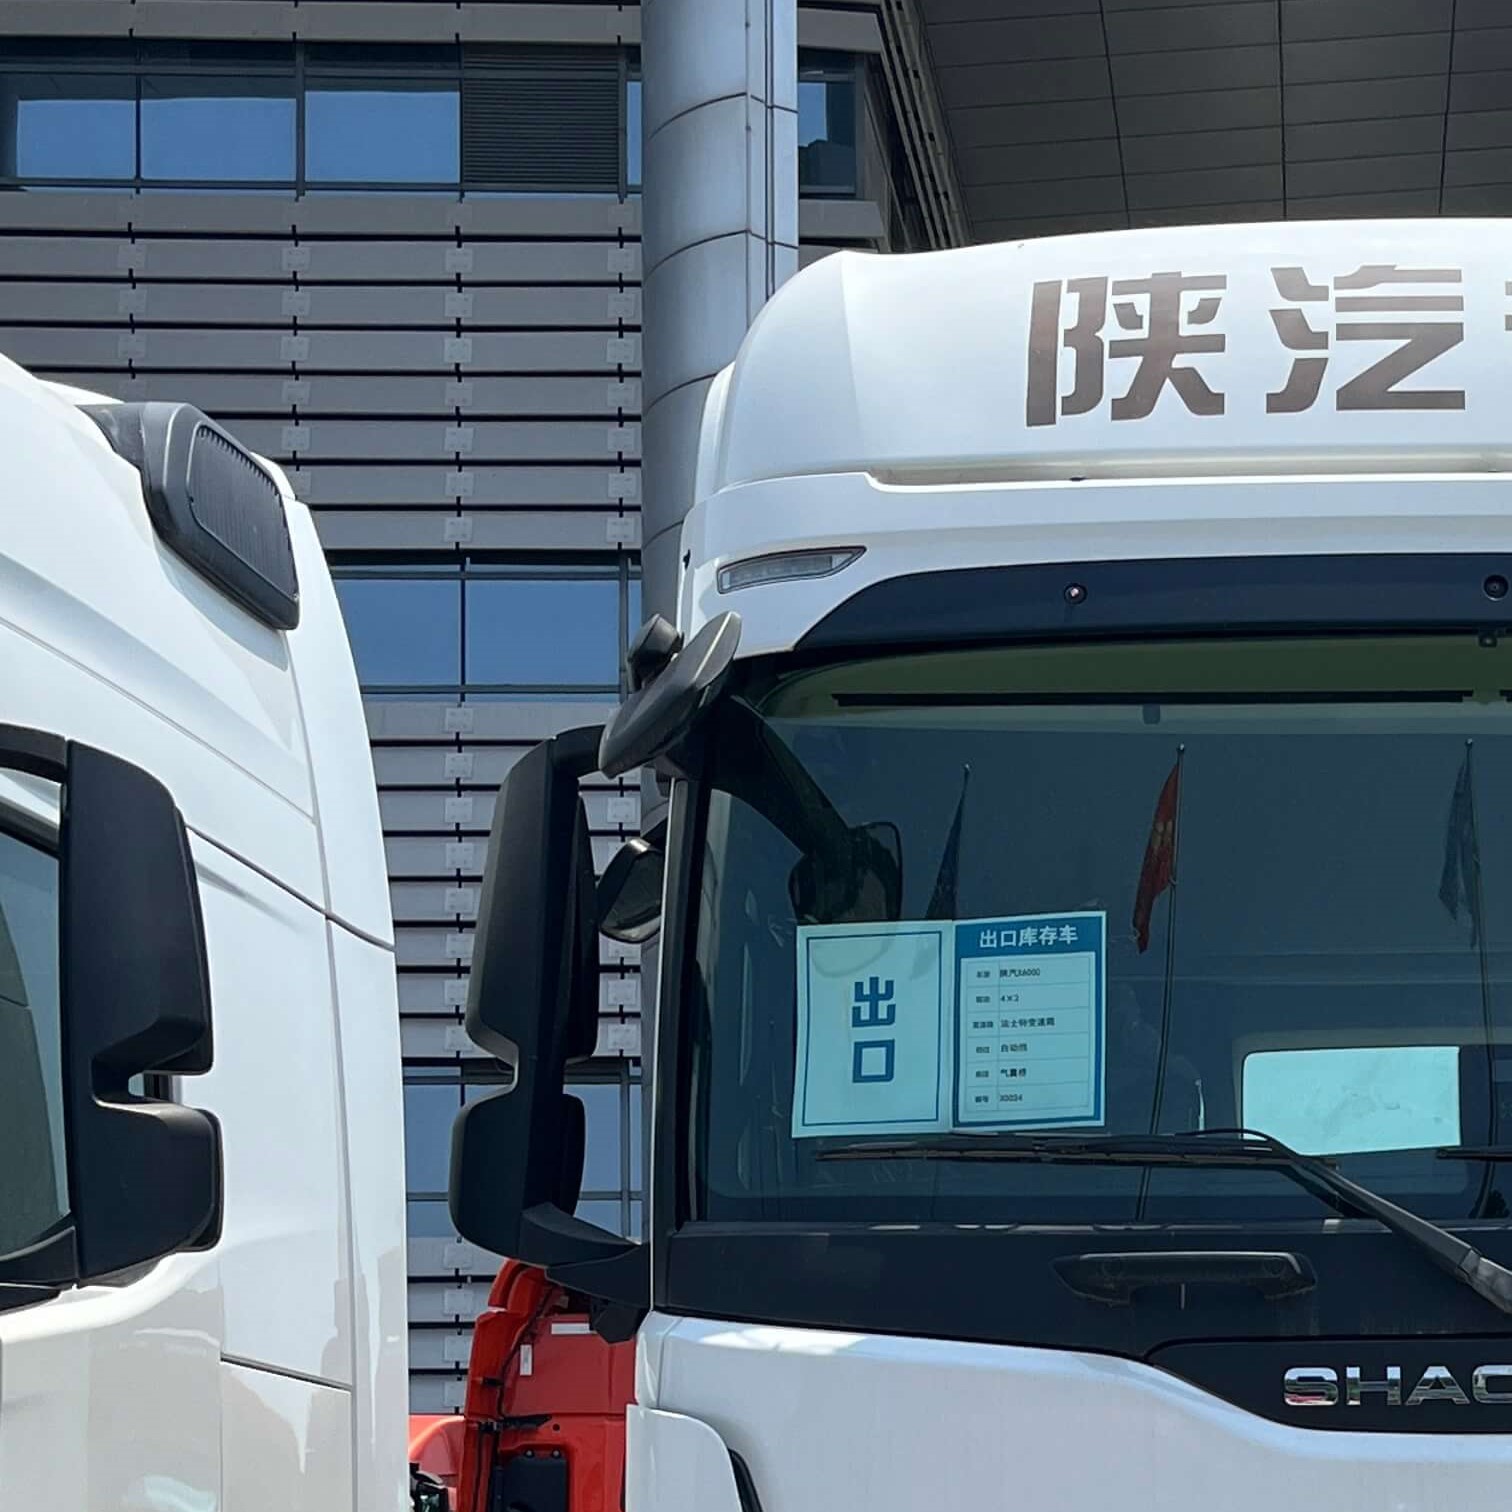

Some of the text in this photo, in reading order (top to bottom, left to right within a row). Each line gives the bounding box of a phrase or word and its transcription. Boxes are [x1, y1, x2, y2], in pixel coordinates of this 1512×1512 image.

[979, 924, 1079, 949] 出口库存车
[851, 975, 897, 1084] 出口
